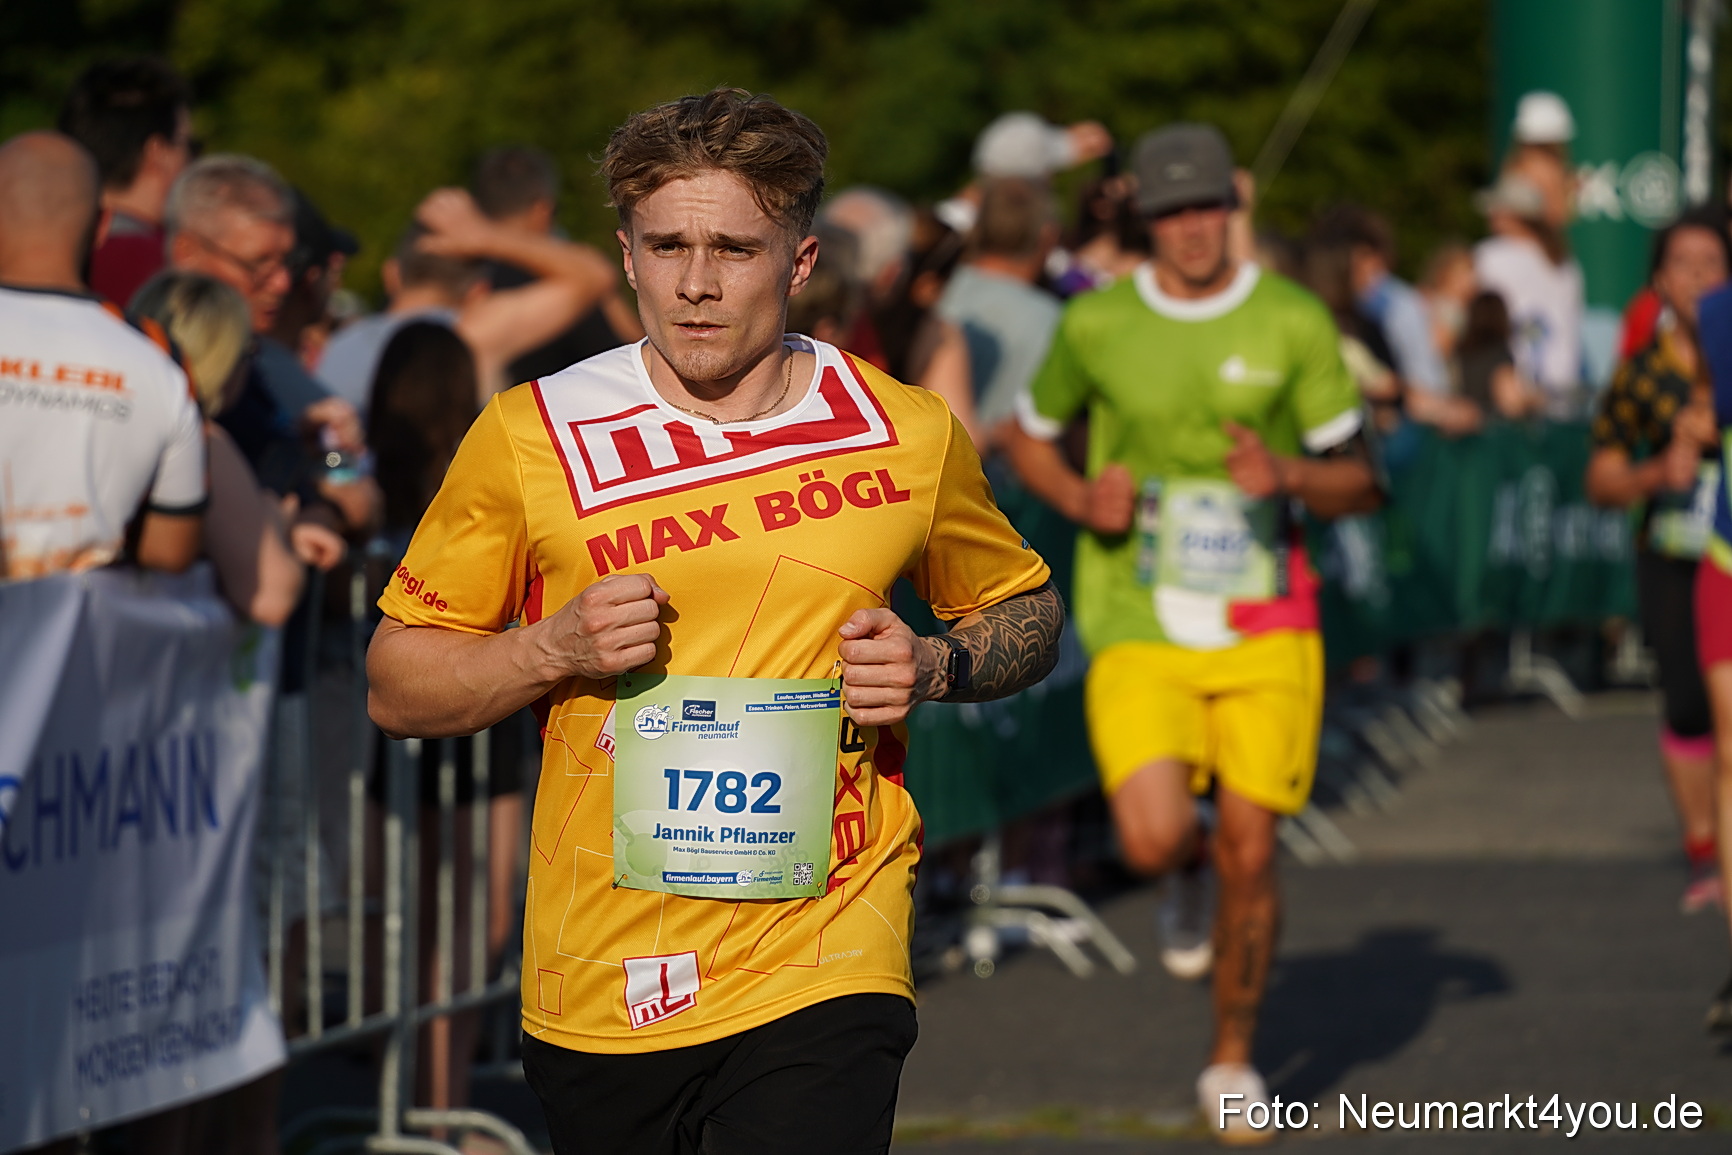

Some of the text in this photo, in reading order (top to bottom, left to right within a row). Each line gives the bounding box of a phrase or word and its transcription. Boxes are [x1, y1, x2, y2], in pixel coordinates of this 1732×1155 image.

[585, 468, 911, 577] MAX BÖGL
[671, 720, 741, 732] Firmenlauf
[698, 731, 739, 739] neumarkt
[663, 768, 782, 814] 1782
[652, 823, 796, 844] Jannik Pflanzer
[665, 873, 734, 884] firmenlauf.bayern
